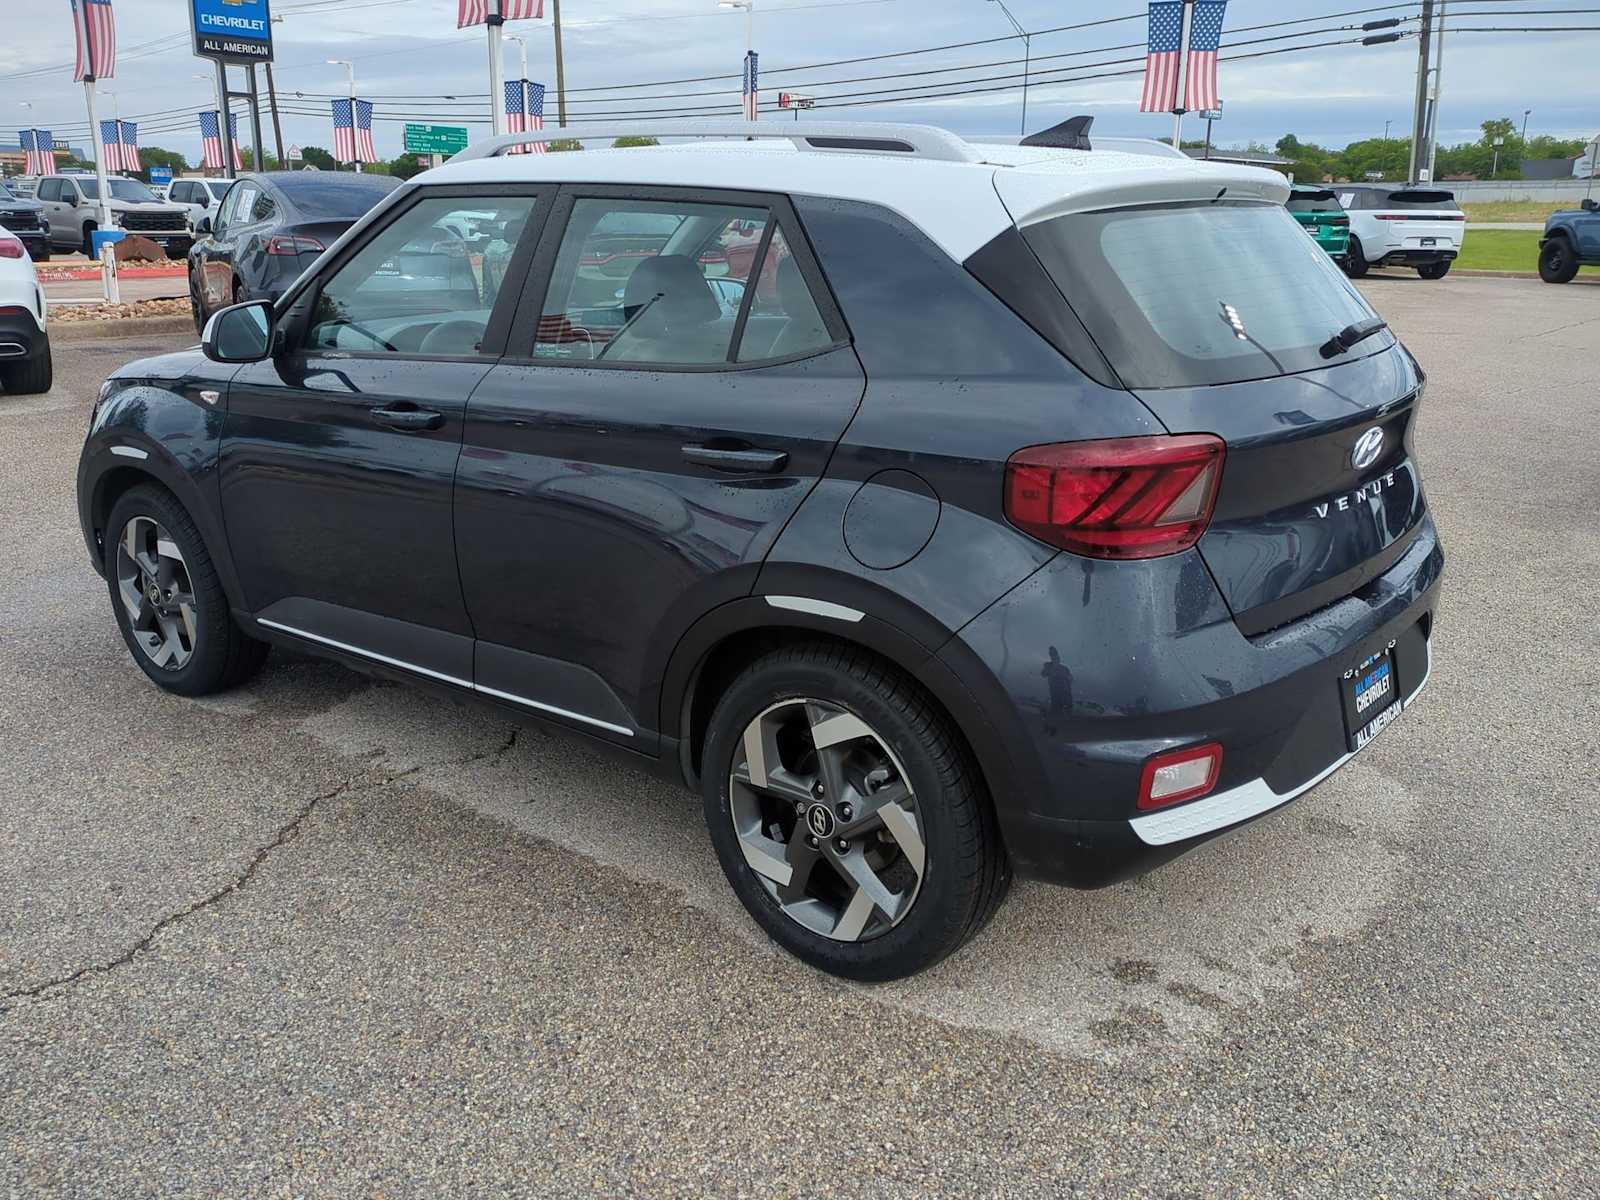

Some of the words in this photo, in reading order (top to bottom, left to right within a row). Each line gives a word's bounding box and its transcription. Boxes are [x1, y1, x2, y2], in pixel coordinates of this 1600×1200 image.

[201, 14, 265, 30] CHEVROLET
[204, 40, 221, 50] ALL
[223, 43, 268, 55] AMERICAN
[1313, 473, 1394, 519] VENUE
[1355, 680, 1366, 696] ALL
[1364, 661, 1389, 690] AMERICAN
[1356, 674, 1390, 713] CHEVROLET
[1357, 728, 1370, 749] ALL
[1370, 699, 1402, 738] AMERICAN
